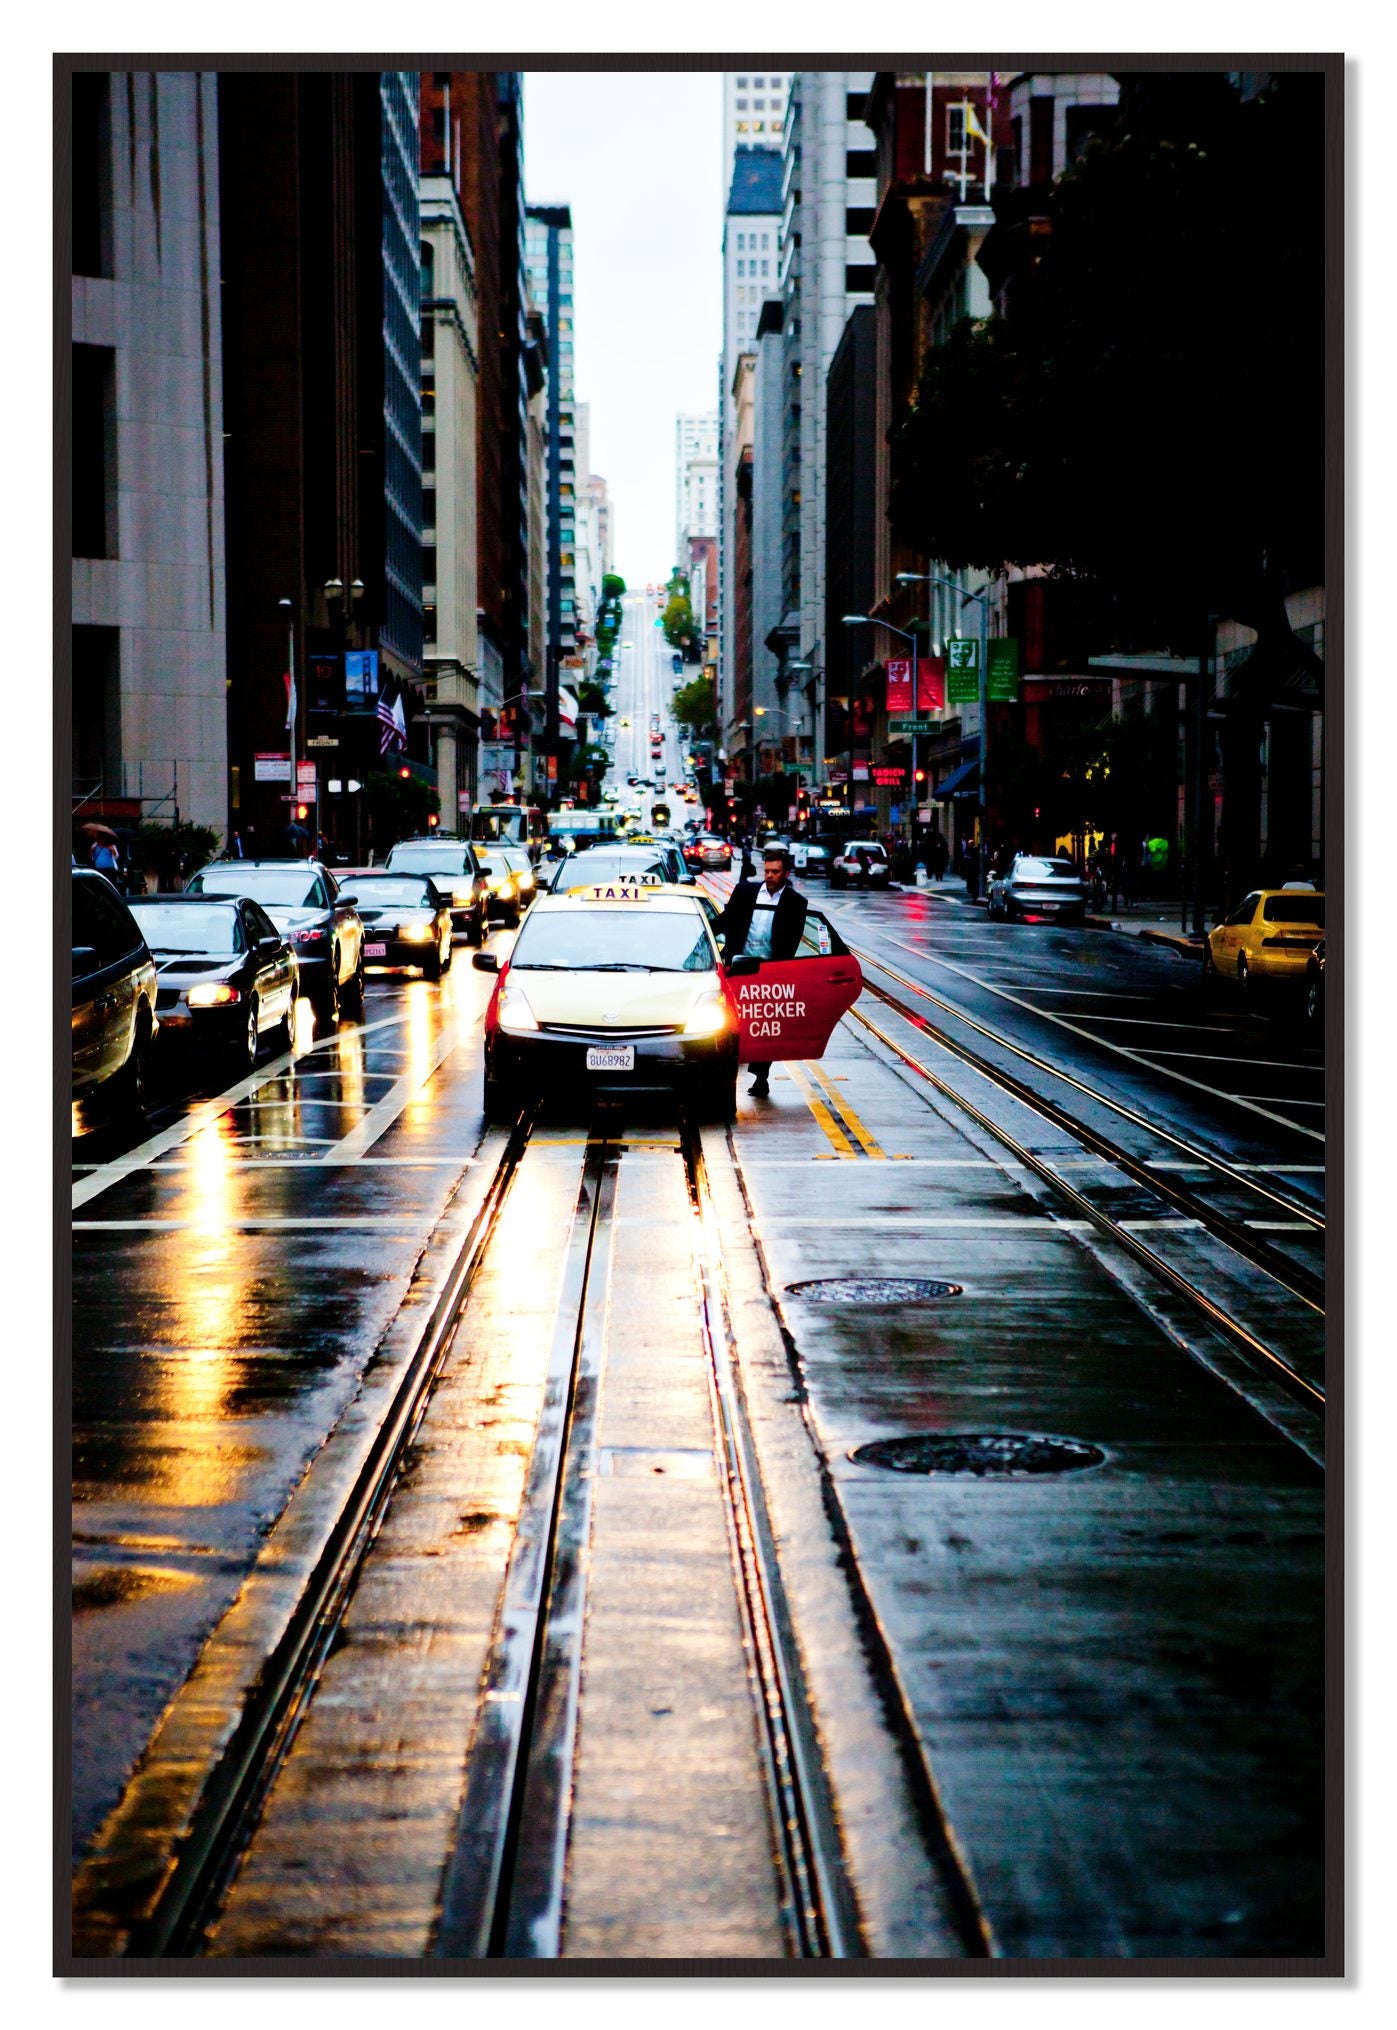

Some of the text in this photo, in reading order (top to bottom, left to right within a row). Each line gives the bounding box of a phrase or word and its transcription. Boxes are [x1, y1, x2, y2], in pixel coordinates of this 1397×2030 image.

[902, 723, 928, 731] Front
[872, 768, 905, 777] TADICH
[876, 777, 900, 785] GRILL
[619, 875, 656, 884] TAXI
[593, 888, 639, 899] TAXI
[739, 984, 796, 1000] ARROW
[749, 1021, 781, 1037] CAB
